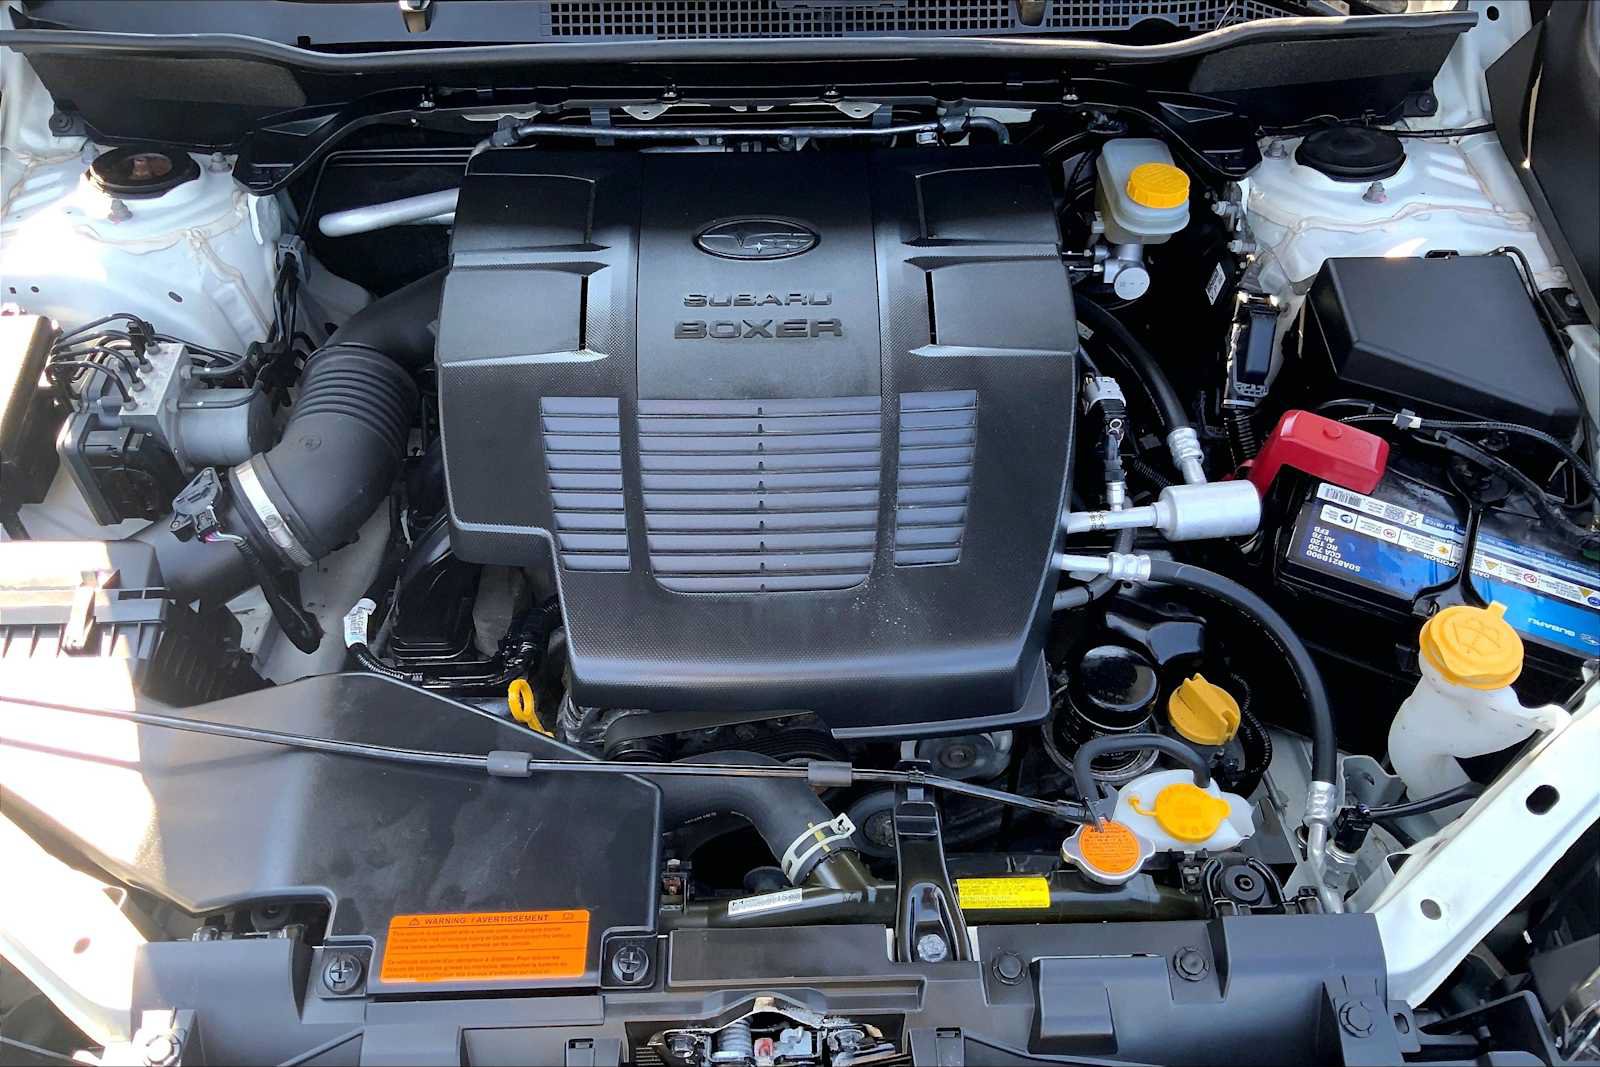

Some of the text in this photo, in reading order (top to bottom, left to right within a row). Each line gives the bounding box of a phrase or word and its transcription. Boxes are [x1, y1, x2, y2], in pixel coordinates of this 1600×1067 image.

[683, 292, 832, 307] SUBARU
[674, 318, 843, 339] BOXER
[1308, 543, 1341, 559] CCA 750
[1310, 537, 1338, 551] RC 120
[1527, 617, 1576, 637] SUBARU
[425, 917, 466, 925] WARNING
